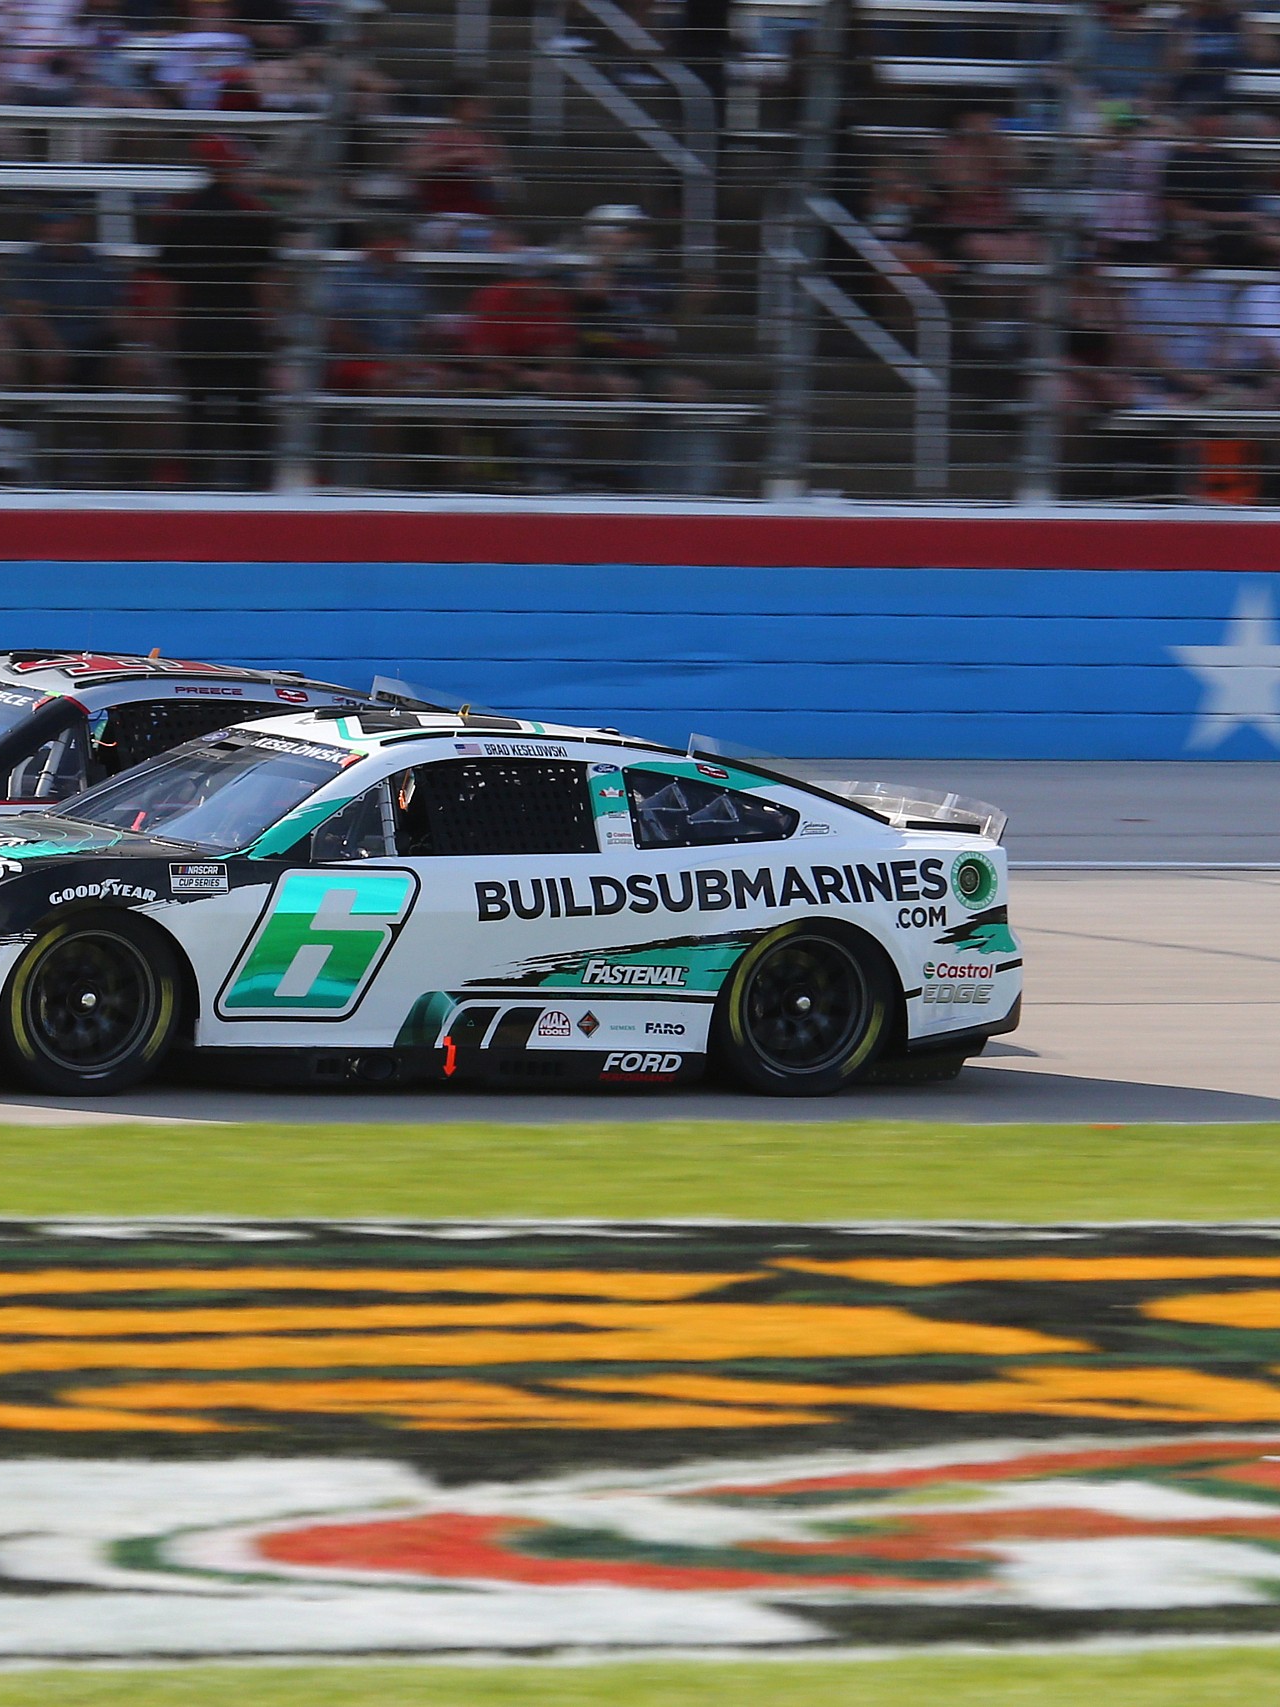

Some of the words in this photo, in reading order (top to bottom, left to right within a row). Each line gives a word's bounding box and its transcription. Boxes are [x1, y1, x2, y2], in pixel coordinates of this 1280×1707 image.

[175, 686, 243, 696] PREECE
[484, 744, 510, 755] BRAD
[510, 745, 568, 757] KESELOWSKI
[188, 866, 218, 874] NASCAR
[195, 879, 220, 887] SERIES
[475, 858, 948, 922] BUILDSUBMARINES
[896, 905, 947, 929] .COM
[223, 874, 412, 1008] 6
[582, 959, 686, 985] FASTENAL
[936, 963, 994, 979] Castrol
[923, 983, 995, 1004] EDGE
[541, 1013, 570, 1029] MAC
[645, 1023, 686, 1035] FARO
[540, 1028, 570, 1036] TOOLS
[602, 1053, 682, 1072] FORD
